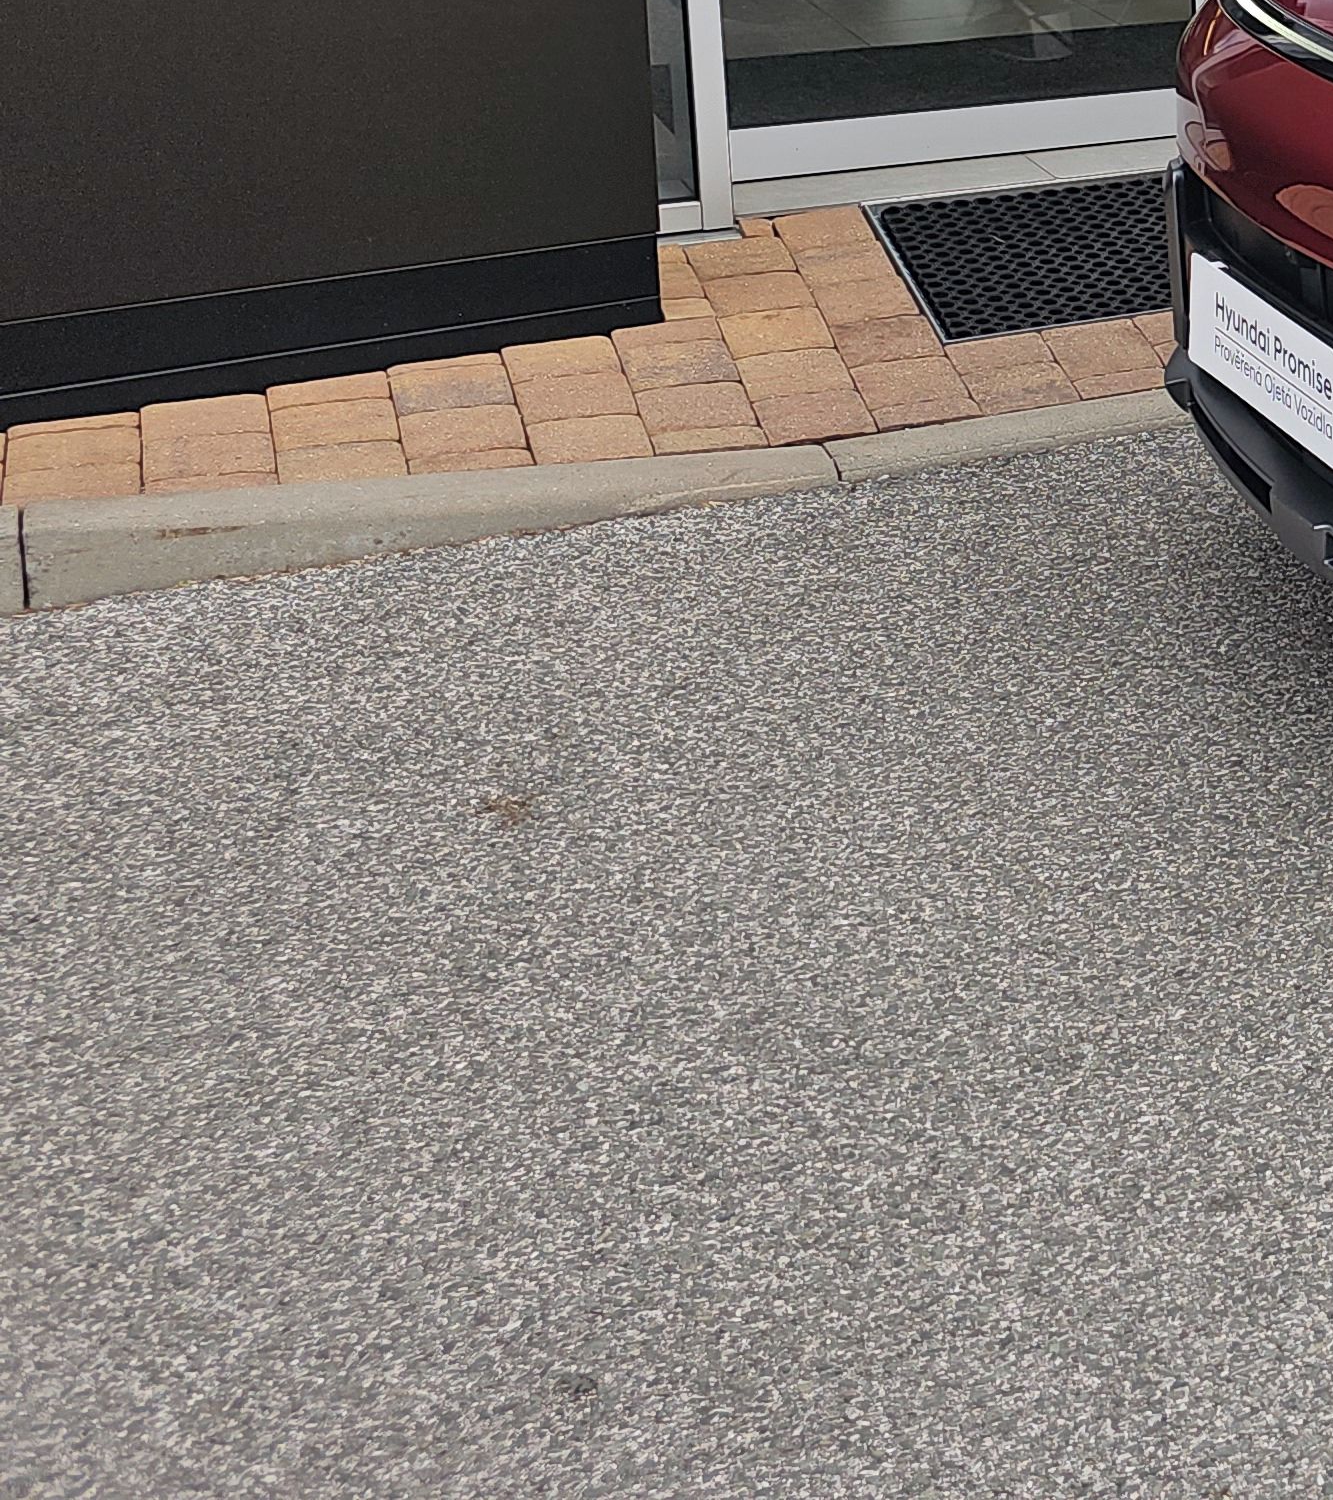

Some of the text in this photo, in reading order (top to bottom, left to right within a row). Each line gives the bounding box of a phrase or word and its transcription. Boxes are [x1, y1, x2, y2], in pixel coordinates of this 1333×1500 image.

[1214, 334, 1333, 440] Prověřená Ojetá Vozidla
[1215, 292, 1333, 401] Hyundai Promise
